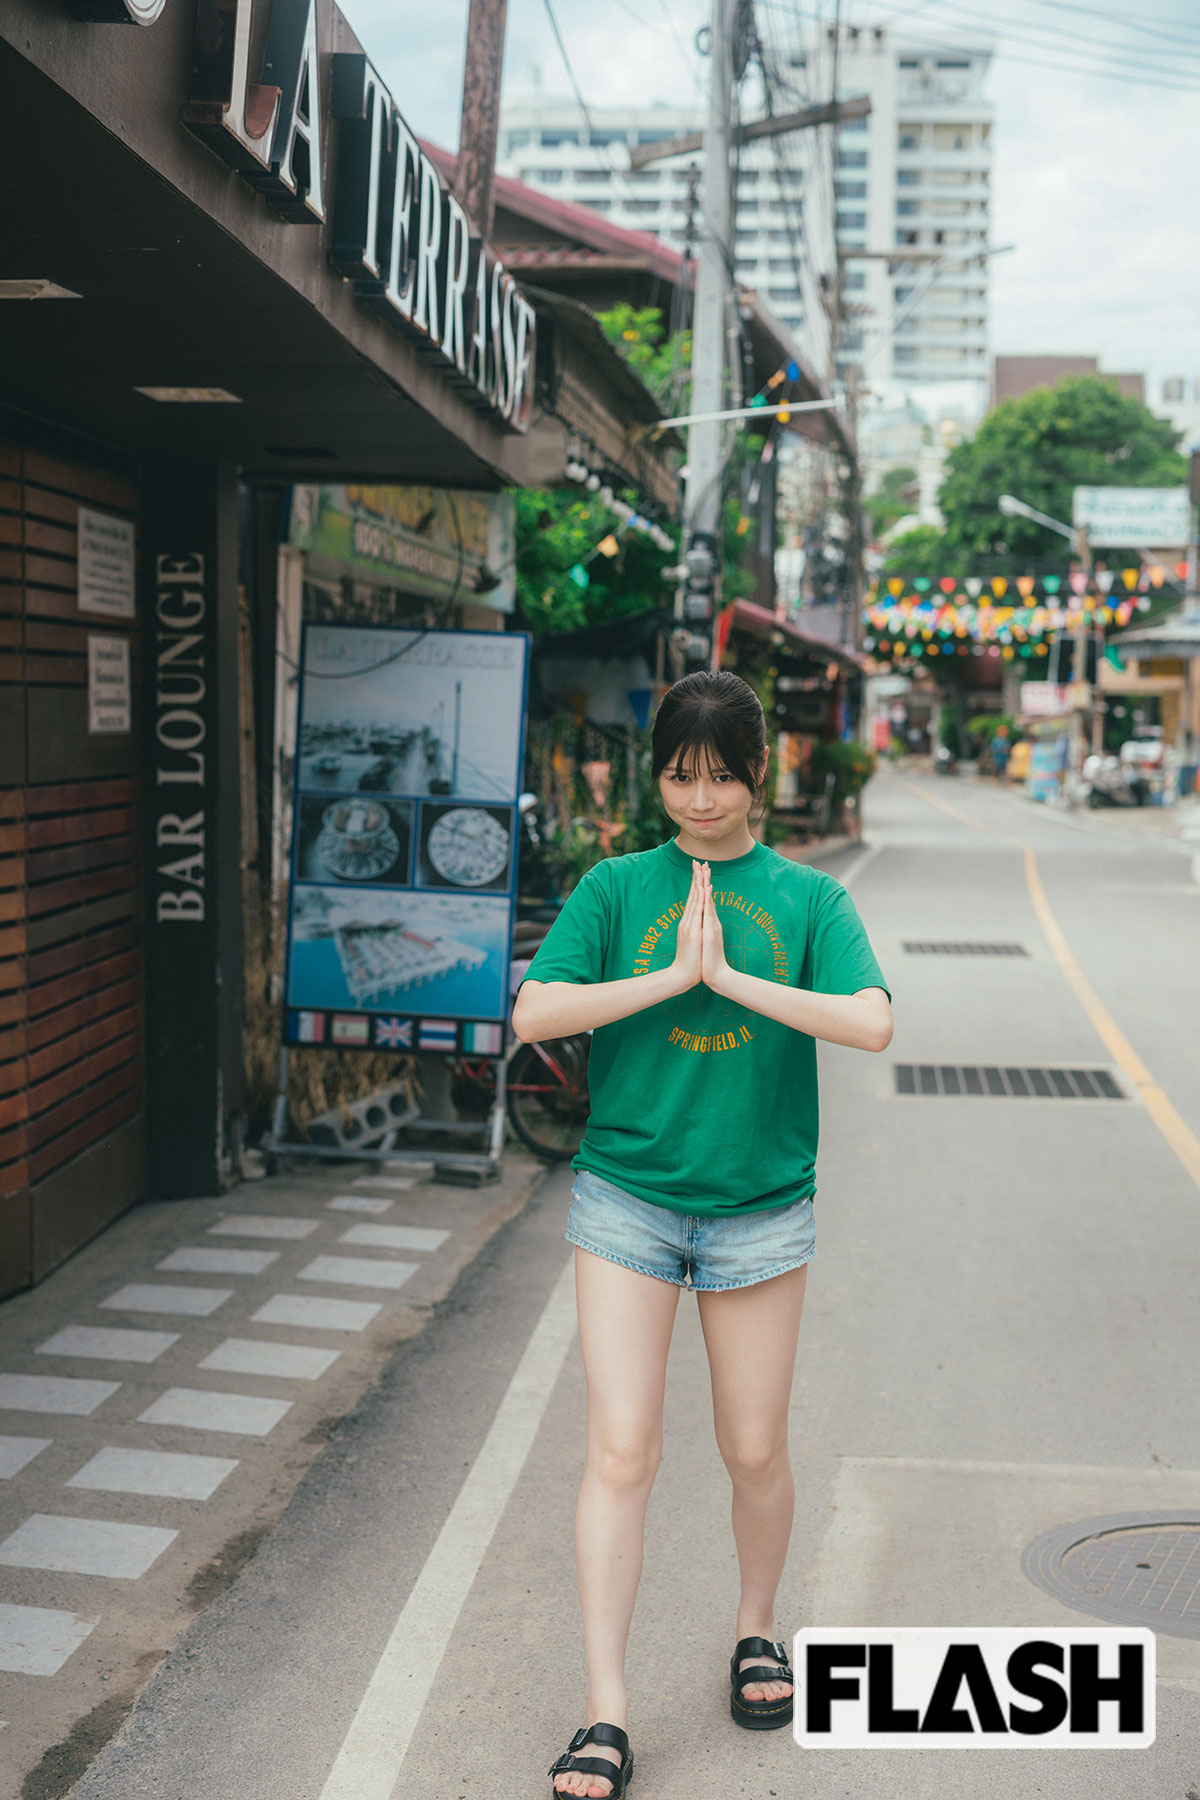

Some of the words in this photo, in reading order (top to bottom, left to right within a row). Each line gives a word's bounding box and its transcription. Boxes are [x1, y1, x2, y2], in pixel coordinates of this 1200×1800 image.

[218, 0, 327, 224] LA
[358, 58, 536, 434] TERRASSE
[315, 633, 356, 662] LA
[155, 552, 206, 786] LOUNGE
[156, 810, 206, 923] BAR
[713, 890, 755, 916] EYBALL
[638, 926, 662, 955] 1982
[752, 907, 789, 985] TOURNAMENT
[632, 958, 651, 975] SA
[668, 1027, 740, 1053] SPRINGFIELD,
